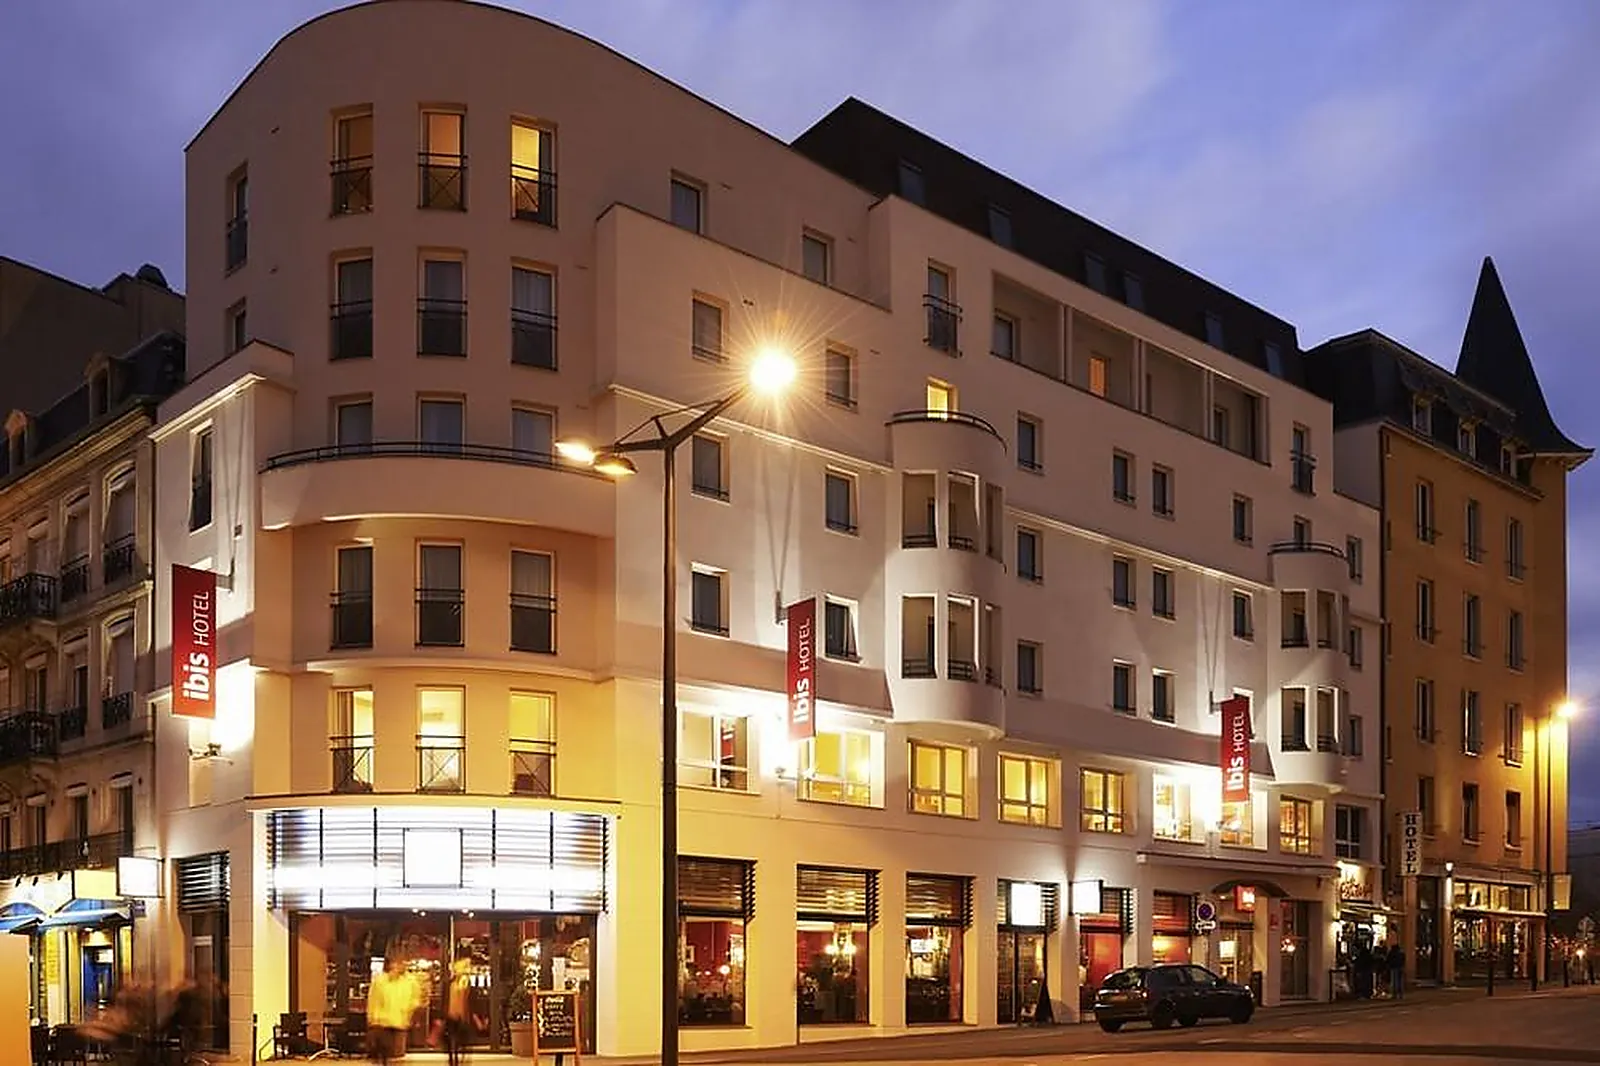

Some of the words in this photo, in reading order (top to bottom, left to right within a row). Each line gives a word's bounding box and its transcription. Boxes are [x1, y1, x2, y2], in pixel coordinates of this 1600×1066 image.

[193, 591, 210, 646] HOTEL
[799, 618, 811, 672] HOTEL
[182, 652, 210, 701] ibis
[793, 677, 810, 724] ibis
[1233, 712, 1245, 753] HOTEL
[1226, 756, 1245, 792] ibis
[1405, 814, 1417, 874] HOTEL
